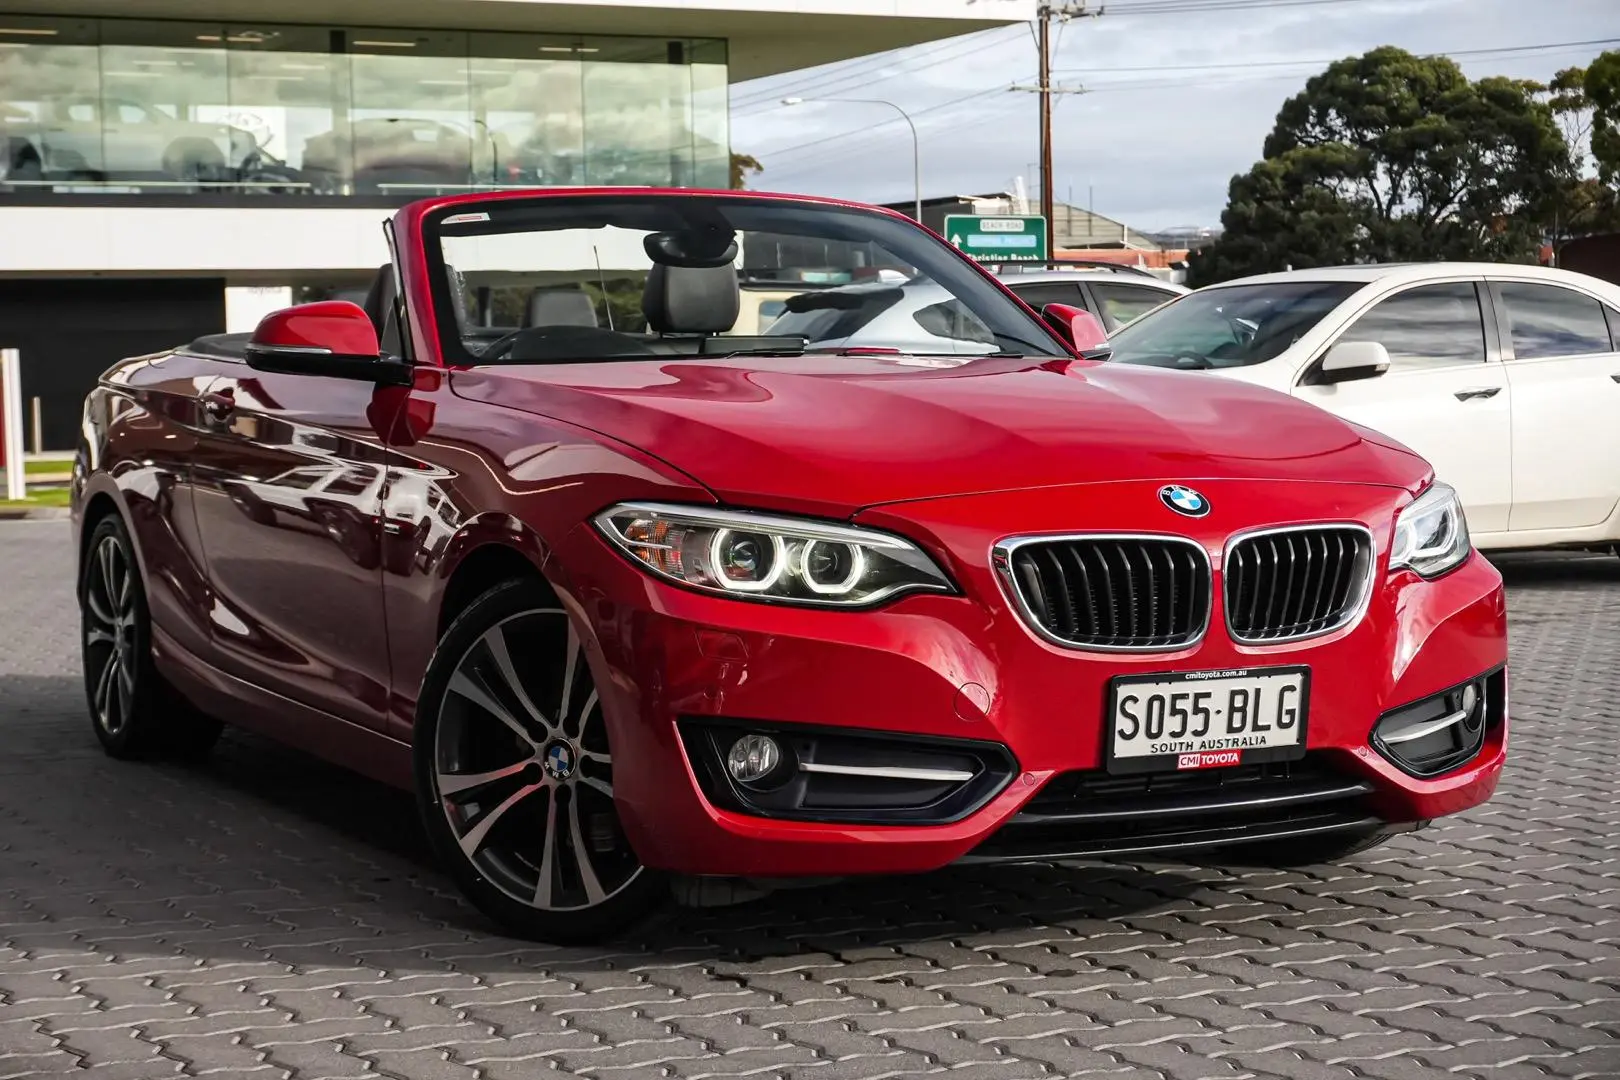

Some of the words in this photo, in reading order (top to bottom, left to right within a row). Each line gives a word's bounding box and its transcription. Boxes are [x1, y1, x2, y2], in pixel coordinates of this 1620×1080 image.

[1185, 670, 1247, 680] cmitoyota.com.au
[1151, 741, 1194, 753] SOUTH
[1200, 735, 1267, 750] AUSTRALIA
[1179, 756, 1200, 767] CMI
[1201, 753, 1239, 765] TOYOTA
